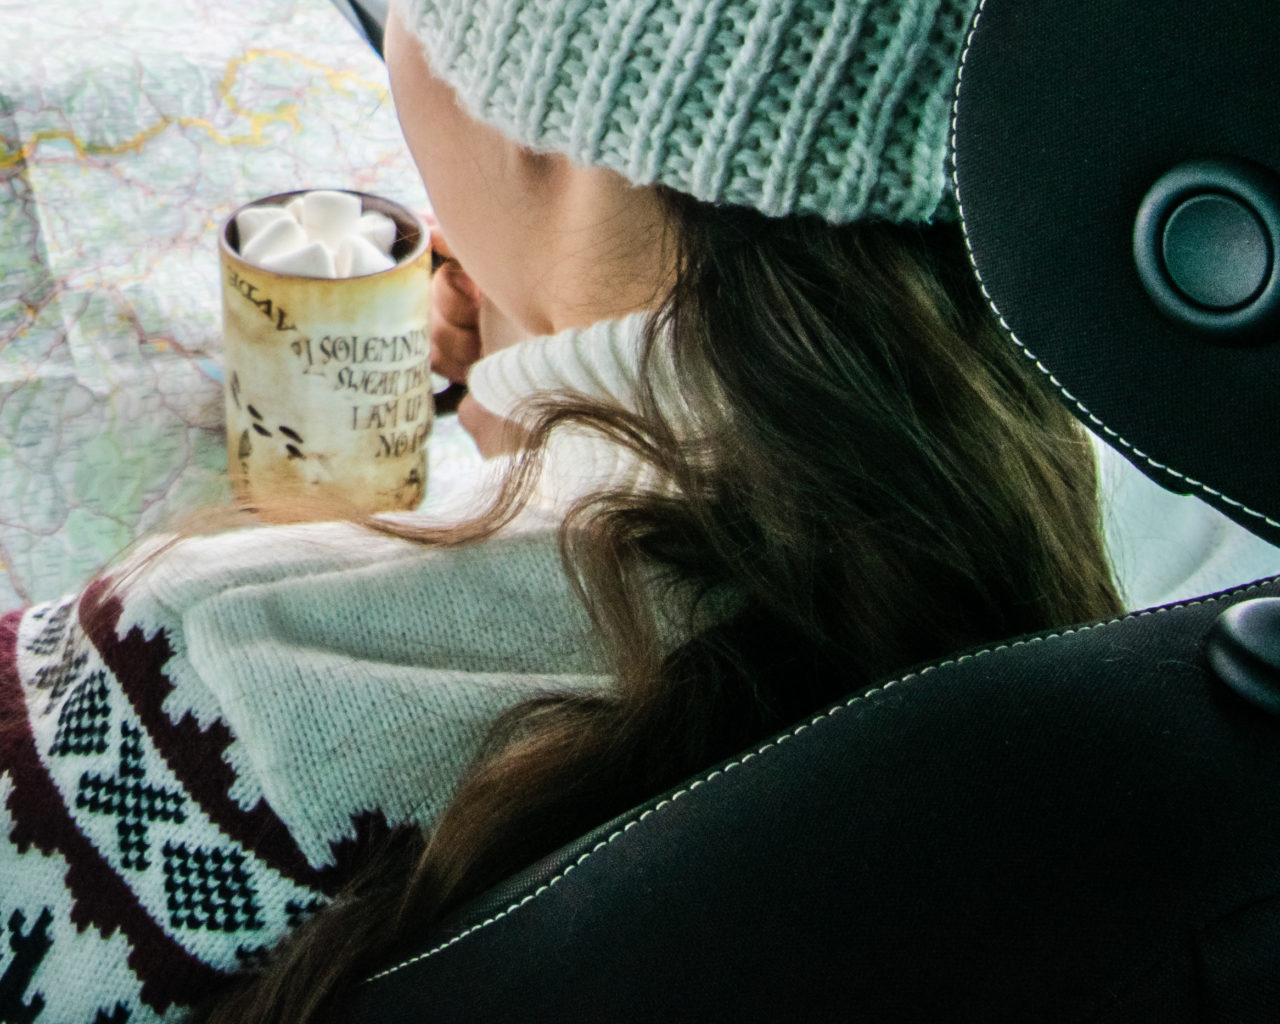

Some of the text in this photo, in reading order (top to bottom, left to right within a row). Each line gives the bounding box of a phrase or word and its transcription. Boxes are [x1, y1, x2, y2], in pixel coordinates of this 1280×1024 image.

[335, 367, 400, 396] SWEAR
[351, 405, 360, 431] I
[367, 400, 398, 429] AM
